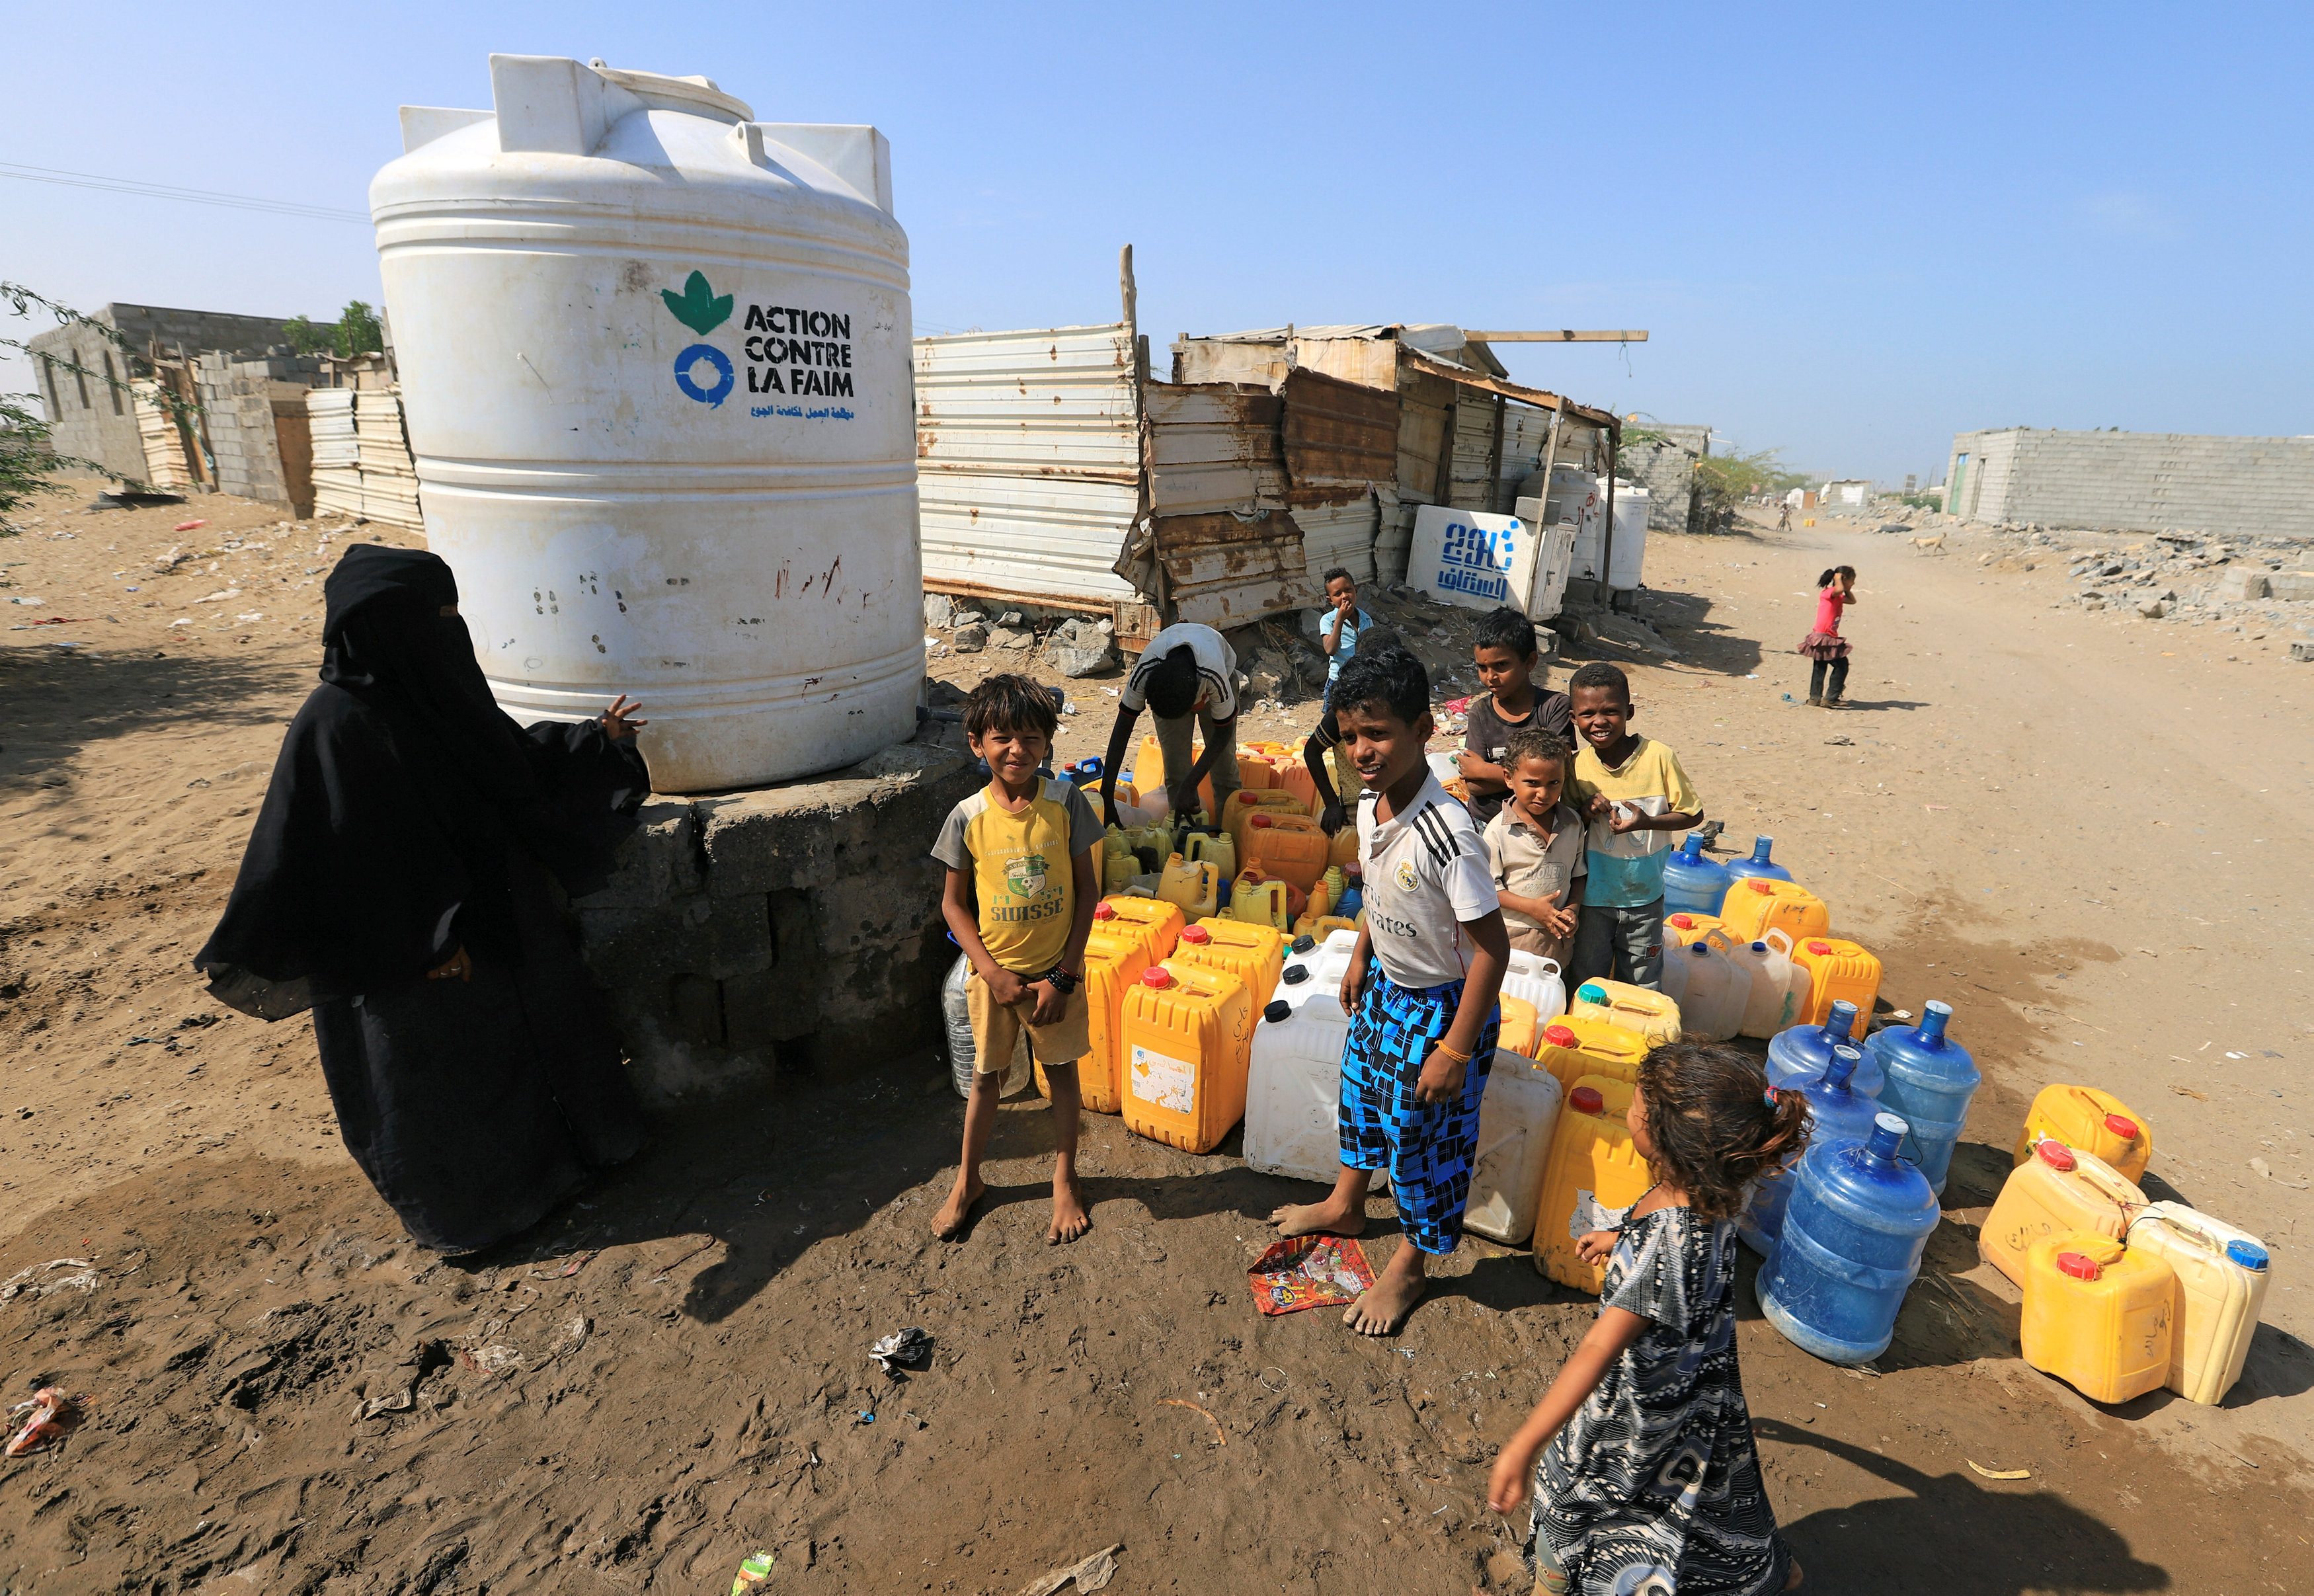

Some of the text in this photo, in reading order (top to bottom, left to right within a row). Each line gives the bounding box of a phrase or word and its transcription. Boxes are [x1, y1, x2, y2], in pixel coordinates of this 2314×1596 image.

[744, 304, 850, 339] ACTION
[744, 336, 852, 368] CONTRE
[747, 366, 854, 397] LA FAIM
[750, 405, 774, 418] الجوع
